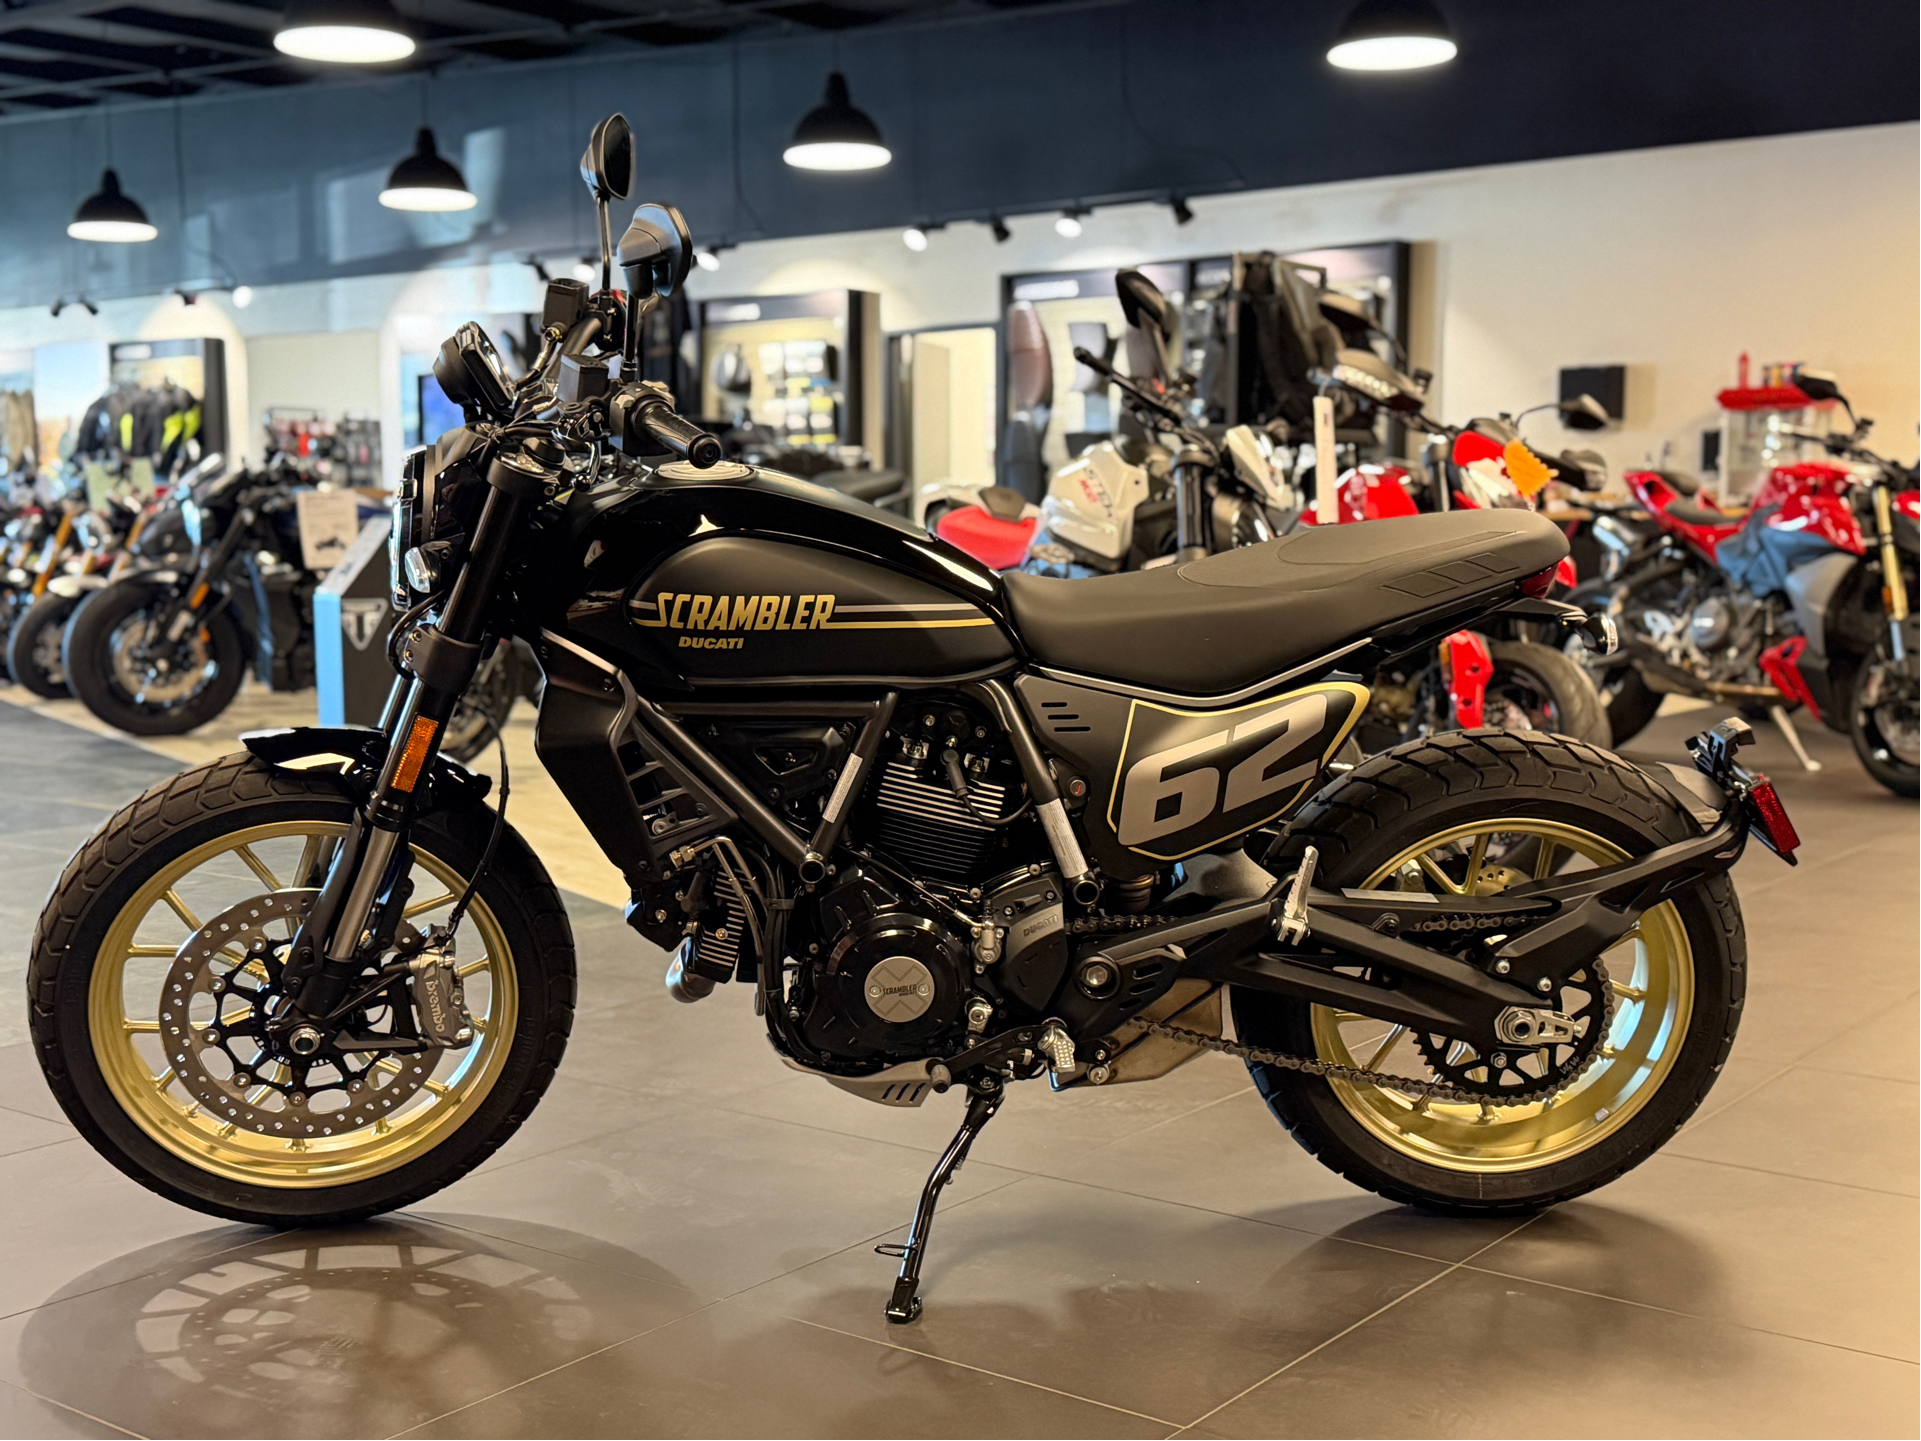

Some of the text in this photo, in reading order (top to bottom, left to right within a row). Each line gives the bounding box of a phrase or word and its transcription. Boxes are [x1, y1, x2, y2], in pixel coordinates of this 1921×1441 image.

[657, 592, 835, 631] SCRAMBLER
[678, 636, 745, 649] DUCATI
[1118, 694, 1327, 846] 62
[1023, 914, 1058, 937] DUCATI
[425, 980, 446, 1033] brembo
